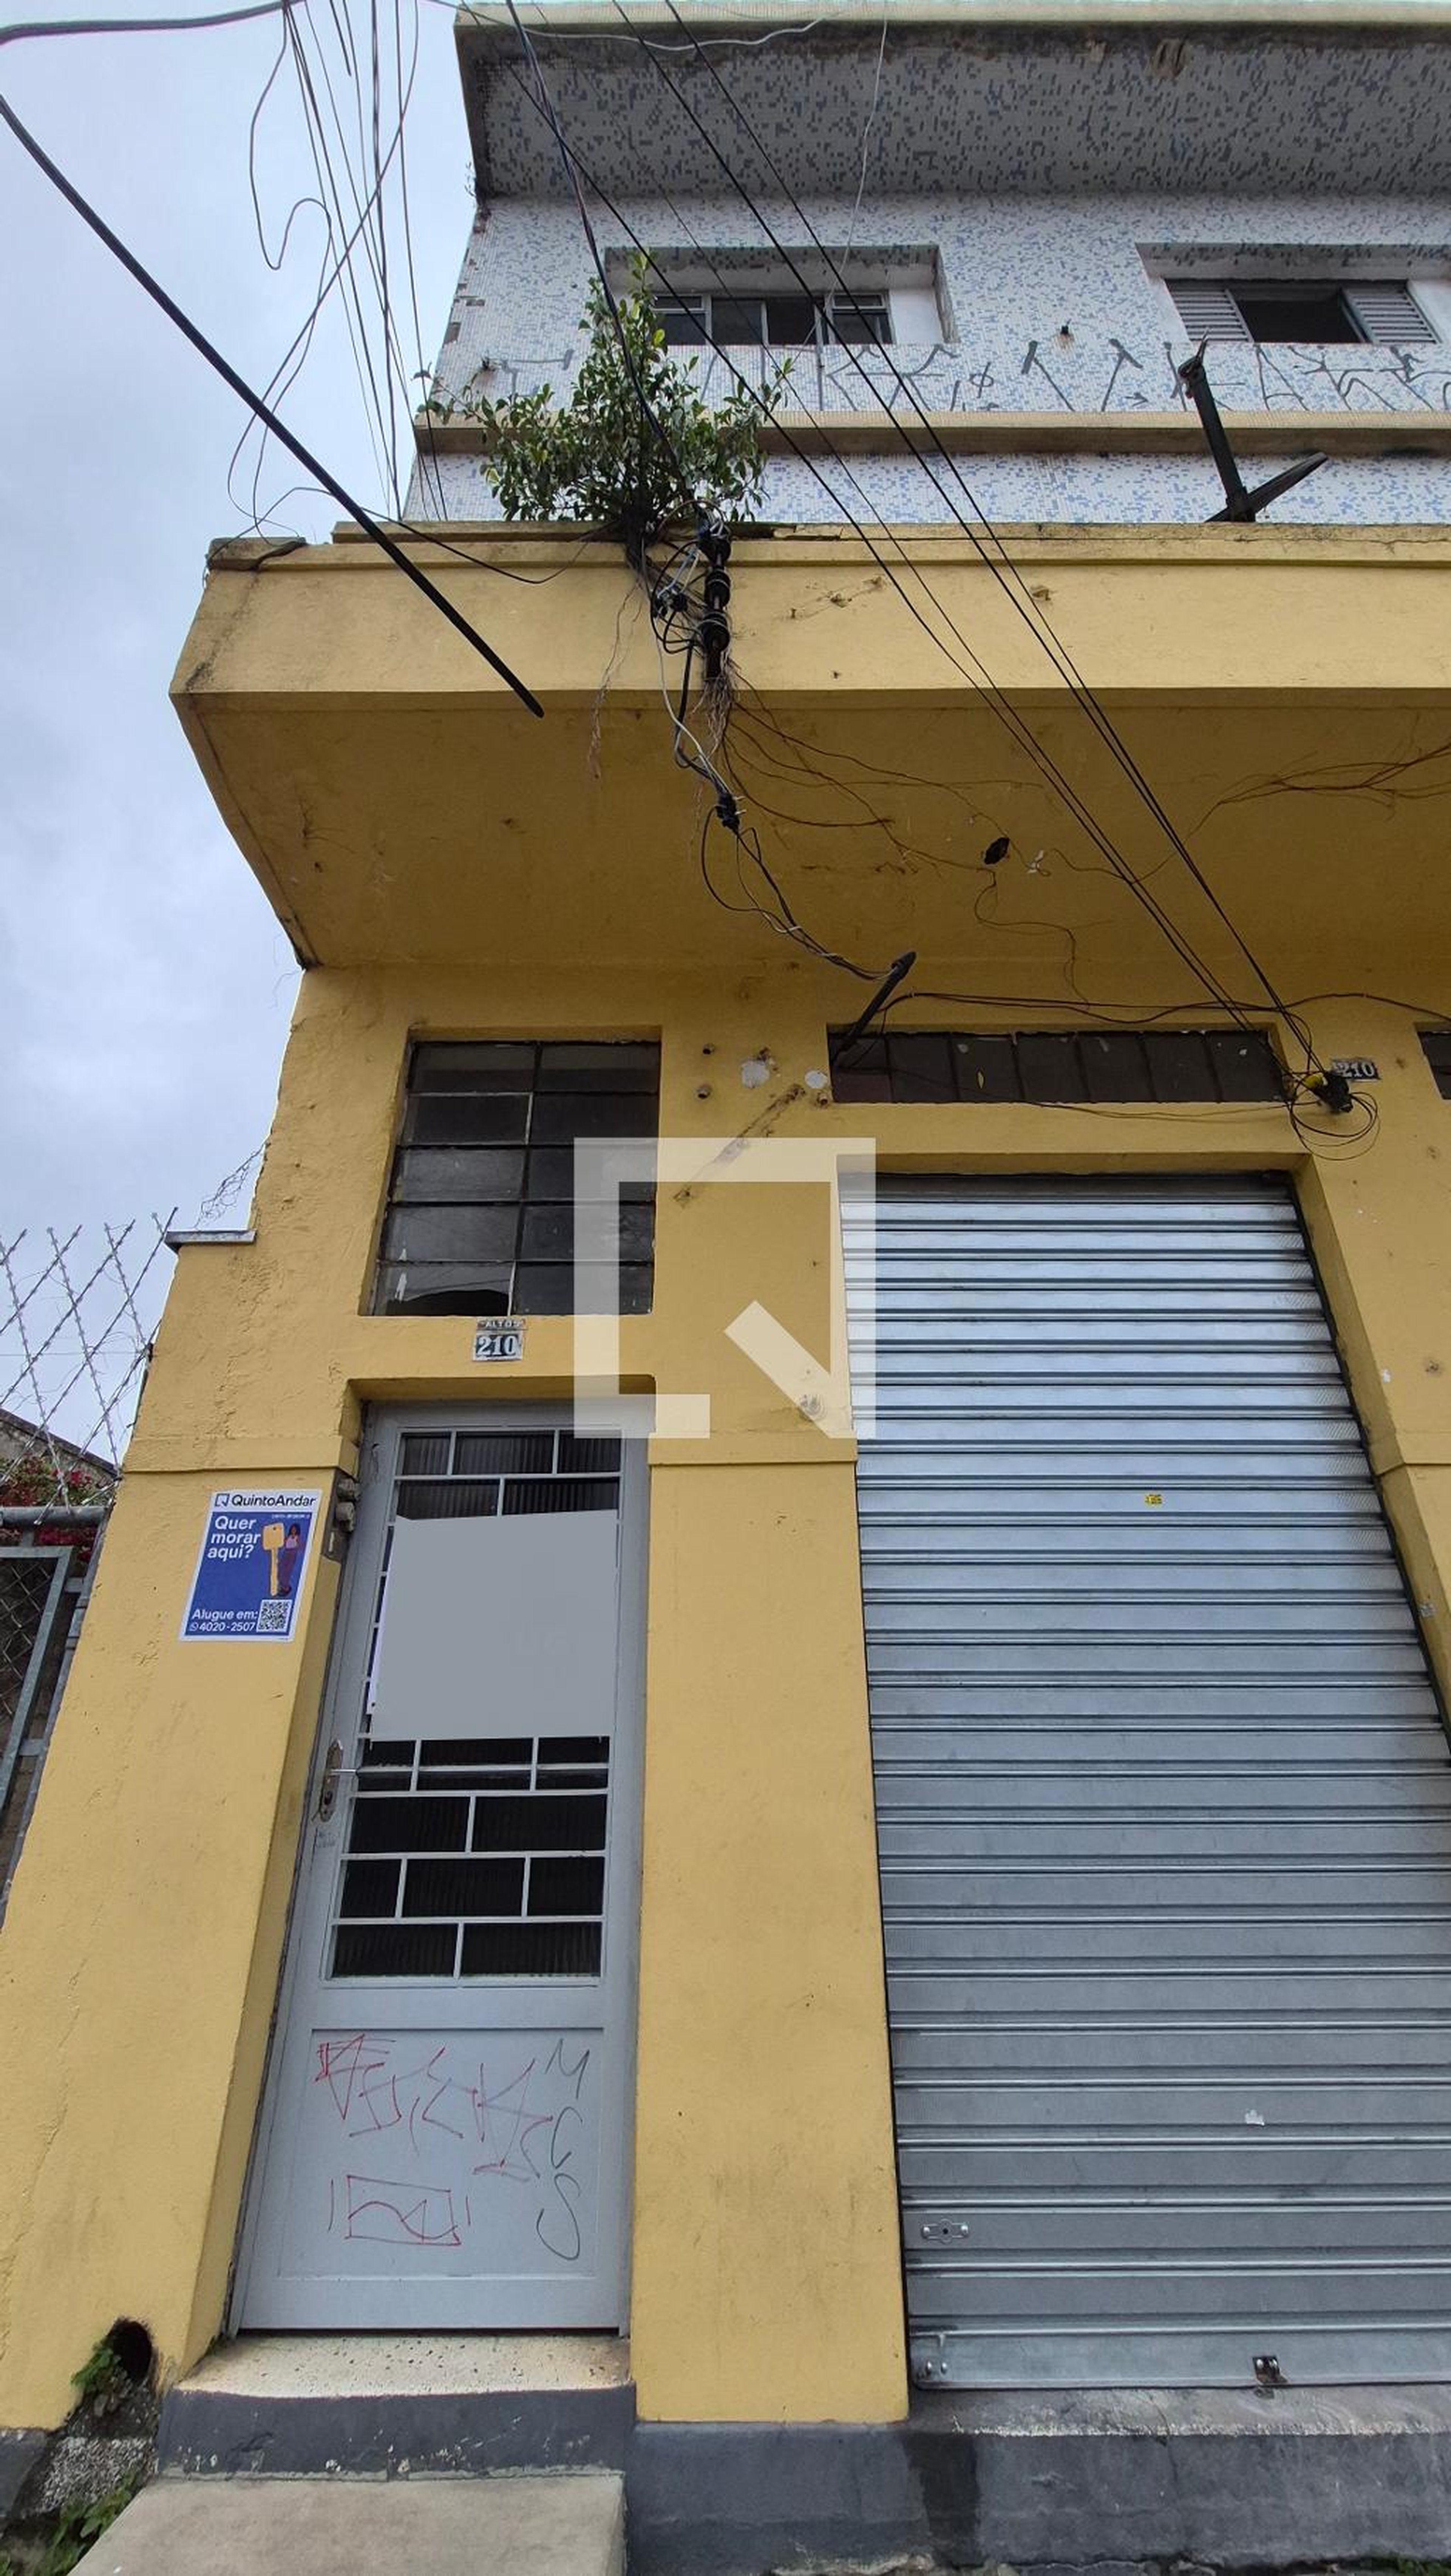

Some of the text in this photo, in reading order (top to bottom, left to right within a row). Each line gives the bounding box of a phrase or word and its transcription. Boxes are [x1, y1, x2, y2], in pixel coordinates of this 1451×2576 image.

[1337, 1061, 1374, 1077] 210
[476, 1335, 518, 1355] 210
[232, 1494, 316, 1506] QuintoAndar
[215, 1516, 256, 1529] Quer
[211, 1533, 261, 1543] morar
[207, 1545, 254, 1561] aqui?
[192, 1609, 258, 1622] Alugue em:
